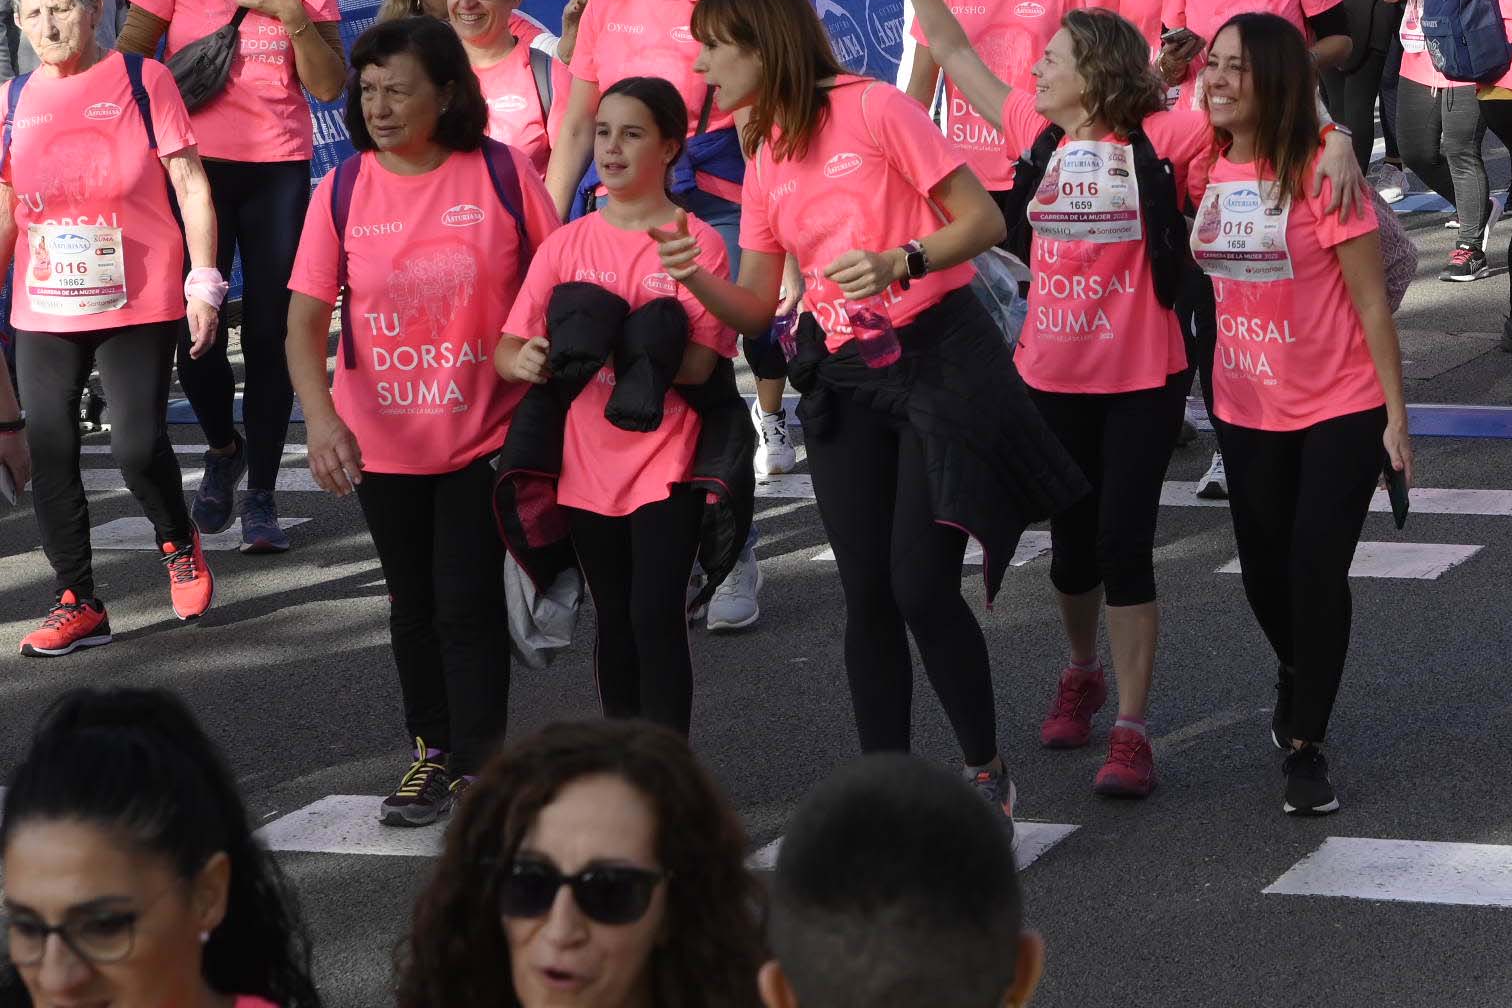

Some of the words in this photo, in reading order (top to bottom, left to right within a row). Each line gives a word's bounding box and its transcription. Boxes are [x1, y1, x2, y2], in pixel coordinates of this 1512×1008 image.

[951, 6, 986, 16] OYSHO
[258, 25, 286, 36] POR
[240, 39, 288, 50] TODAS
[1062, 182, 1099, 196] 016
[1070, 201, 1092, 209] 1659
[352, 221, 402, 238] OYSHO
[1223, 221, 1254, 235] 016
[1227, 240, 1246, 249] 1658
[55, 261, 88, 274] 016
[1037, 270, 1135, 299] DORSAL
[364, 312, 400, 337] TU
[1037, 306, 1111, 334] SUMA
[372, 343, 488, 371] DORSAL
[1219, 349, 1273, 376] UMA
[377, 382, 464, 407] SUMA
